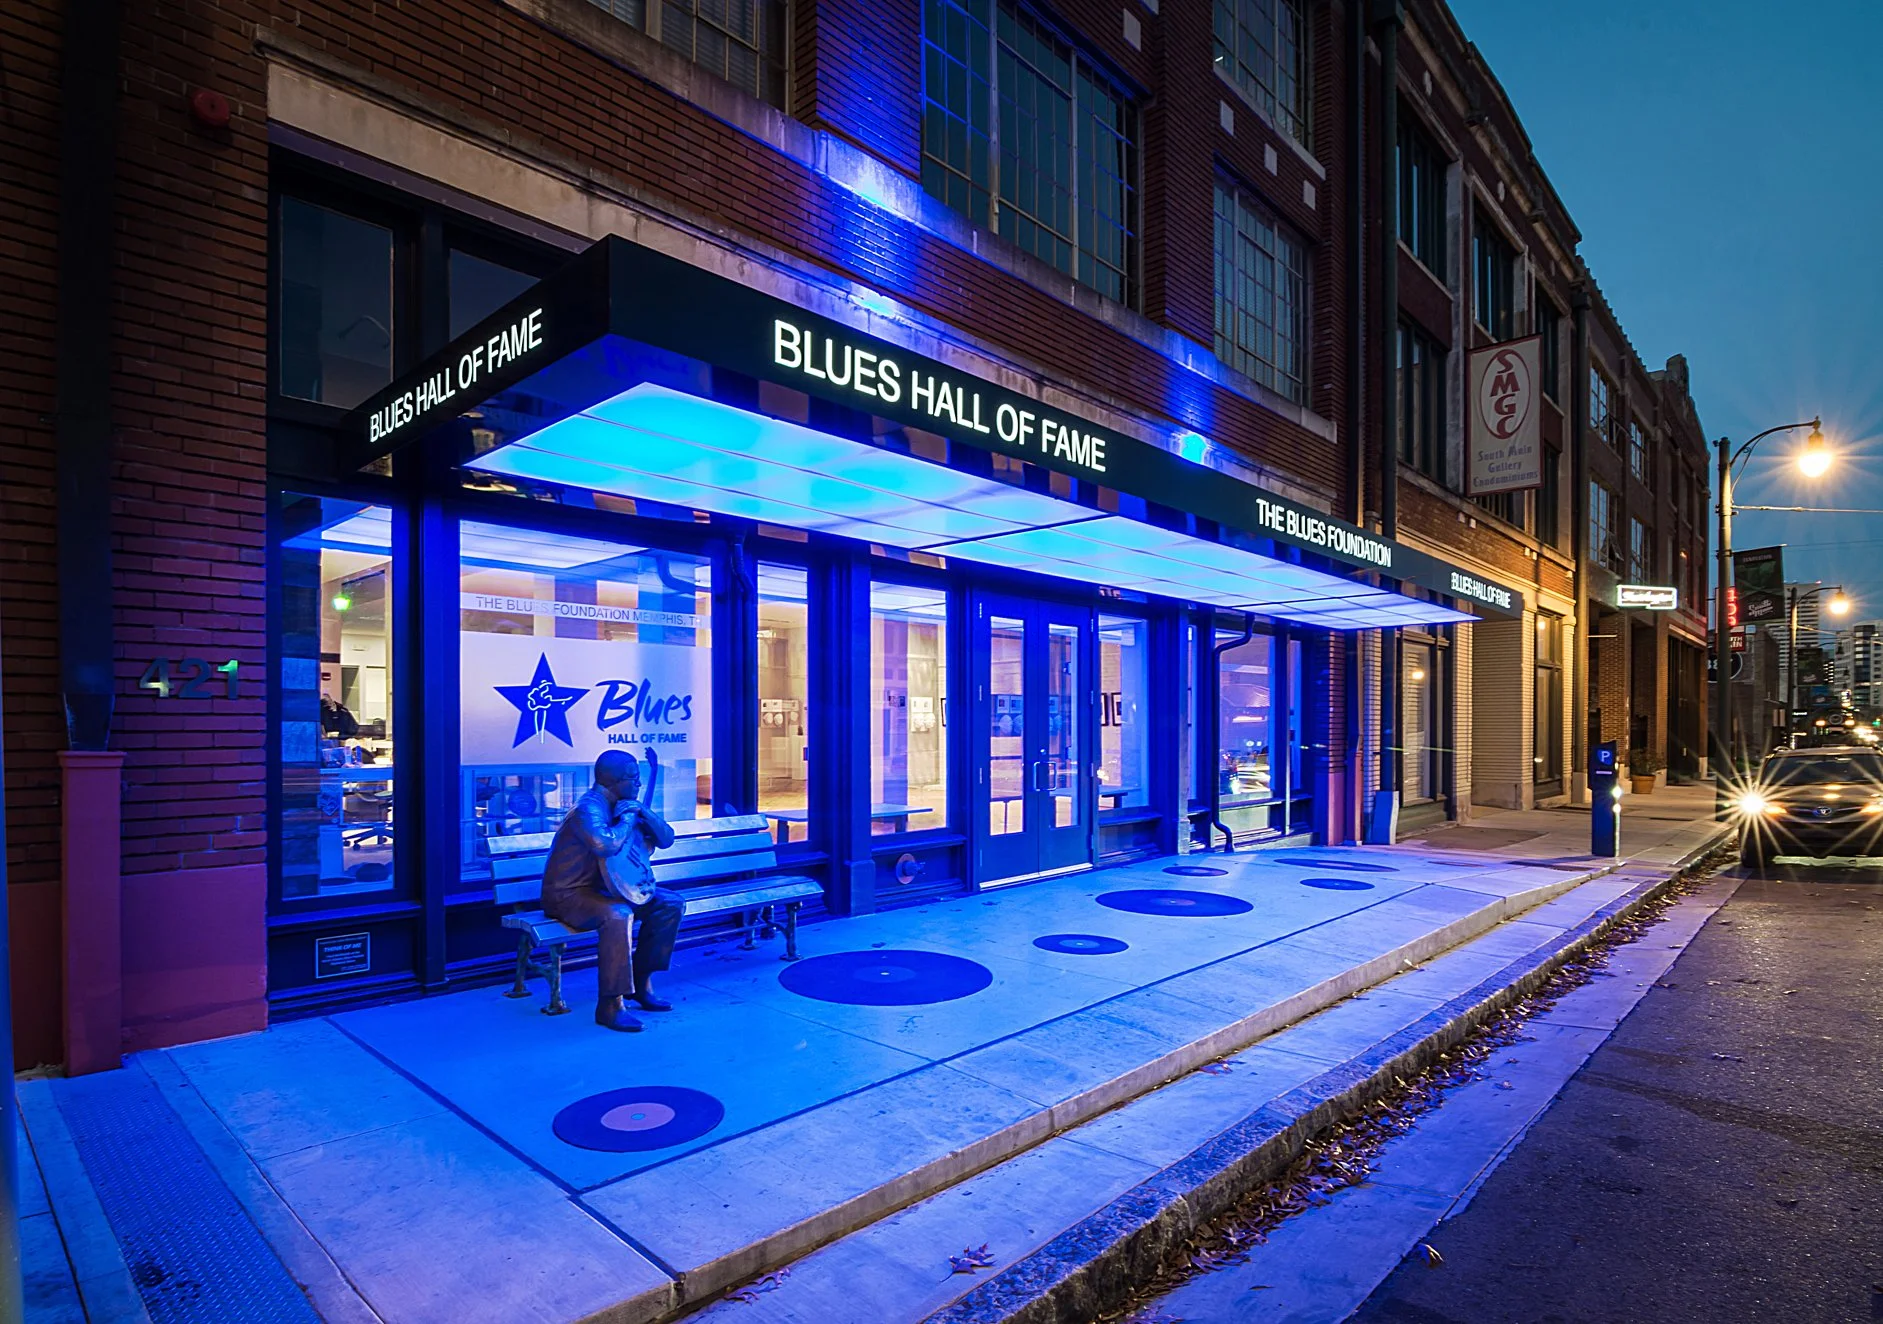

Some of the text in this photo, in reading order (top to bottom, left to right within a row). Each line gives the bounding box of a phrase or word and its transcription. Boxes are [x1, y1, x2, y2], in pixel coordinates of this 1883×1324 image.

[369, 307, 543, 443] BLUES HALL OF FAME
[774, 318, 1106, 473] BLUES HALL OF FAME
[1477, 445, 1533, 462] South Main
[1487, 461, 1522, 473] Gallery
[1473, 469, 1539, 488] Condominiums
[1255, 498, 1392, 568] THE BLUES FOUNDATION
[1451, 571, 1473, 596] BLUES
[1472, 579, 1488, 601] HALL
[1487, 585, 1497, 603] OF
[475, 596, 503, 610] THE
[507, 599, 550, 613] BLUES
[553, 603, 630, 621] FOUNDATION
[139, 658, 239, 700] 421
[595, 678, 692, 731] Blues
[608, 733, 687, 744] HALL OF FAME
[1601, 751, 1611, 762] P
